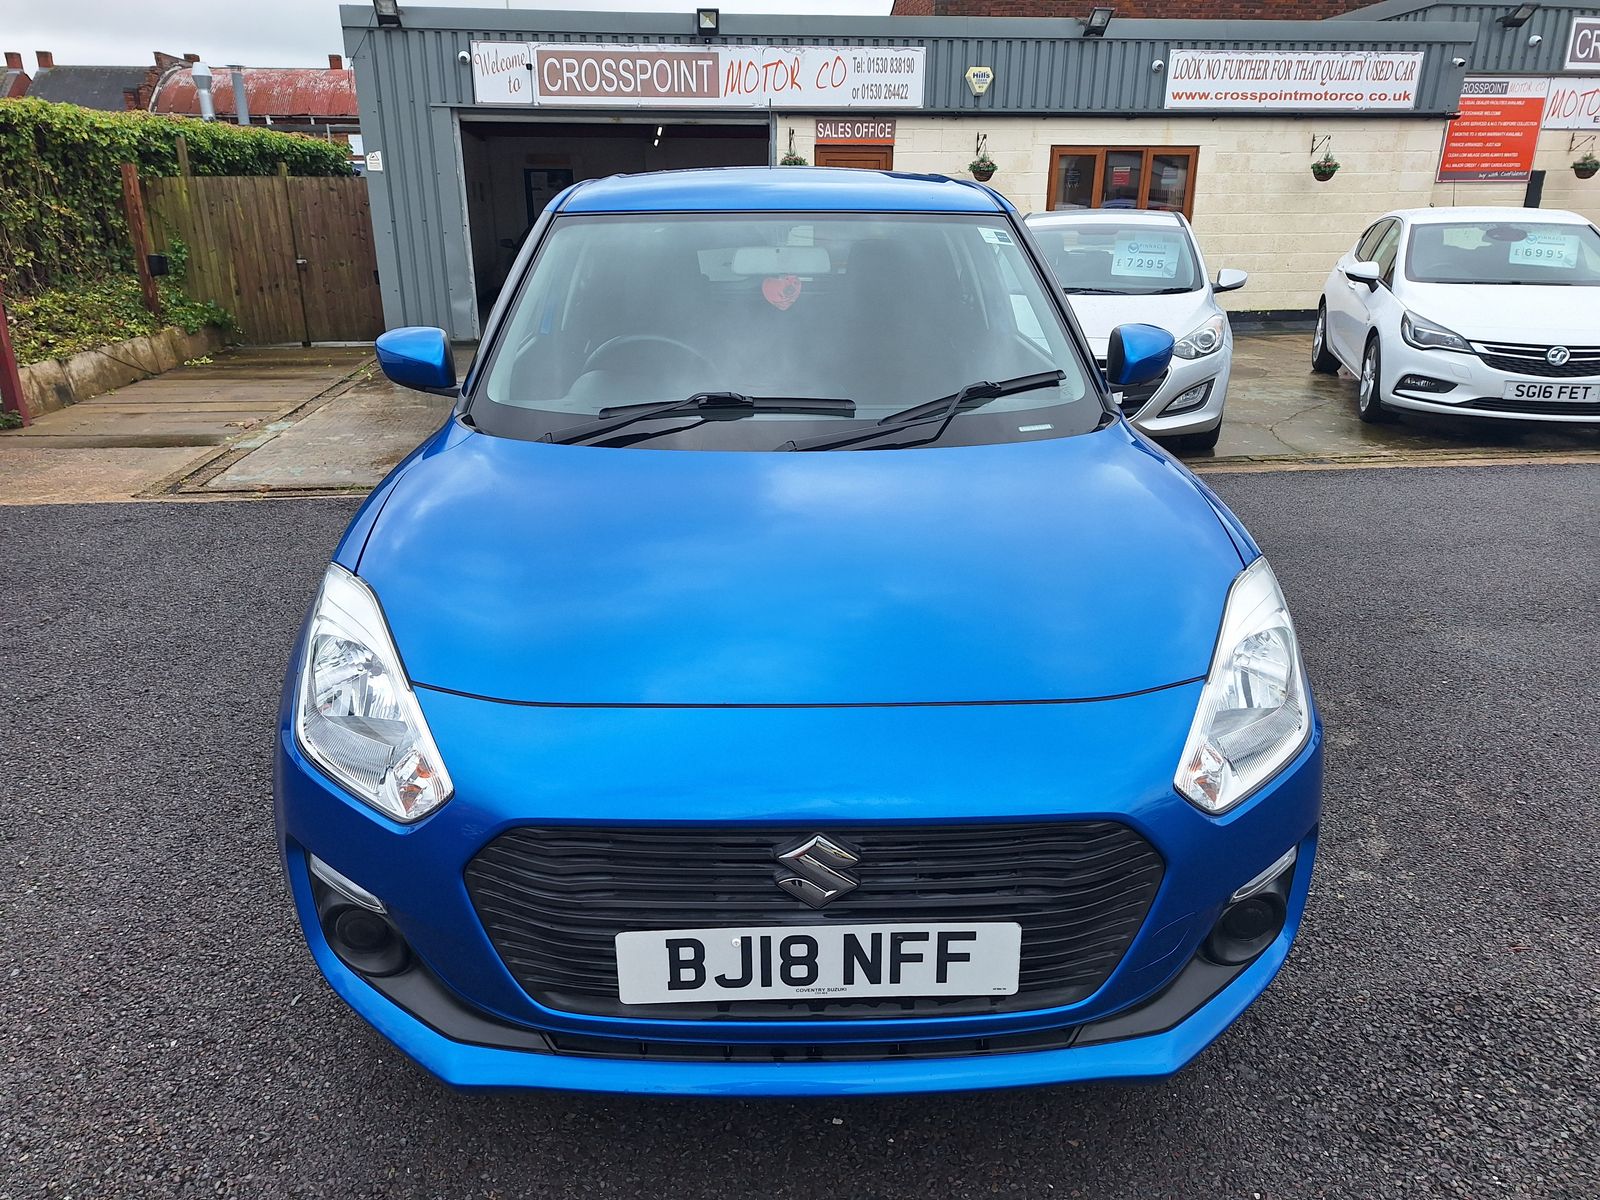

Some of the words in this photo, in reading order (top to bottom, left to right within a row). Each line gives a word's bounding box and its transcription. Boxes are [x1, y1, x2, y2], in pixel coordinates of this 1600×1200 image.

[1576, 29, 1600, 59] CR
[474, 48, 526, 77] Welcome
[852, 57, 865, 73] Tel:
[867, 57, 888, 73] 01530
[889, 57, 914, 73] 838190
[1173, 58, 1204, 79] LOOK
[1204, 59, 1221, 80] NO
[1221, 59, 1270, 80] FURTHER
[1270, 59, 1293, 80] FOR
[1293, 60, 1322, 80] THAT
[1320, 59, 1367, 86] QUALITY
[1366, 60, 1394, 81] USED
[1394, 60, 1417, 81] CAR
[508, 75, 521, 94] to
[543, 57, 713, 93] CROSSPOINT
[723, 56, 802, 97] MOTOR
[816, 55, 847, 89] CO
[852, 87, 860, 99] or
[861, 83, 882, 99] 01530
[883, 83, 909, 99] 264422
[1508, 81, 1533, 94] MOTOR
[1535, 80, 1546, 92] CO
[817, 122, 852, 138] SALES
[854, 122, 892, 138] OFFICE
[1514, 384, 1554, 399] SG16
[1557, 385, 1592, 400] FET
[665, 934, 819, 990] BJ18
[842, 931, 977, 986] NFF
